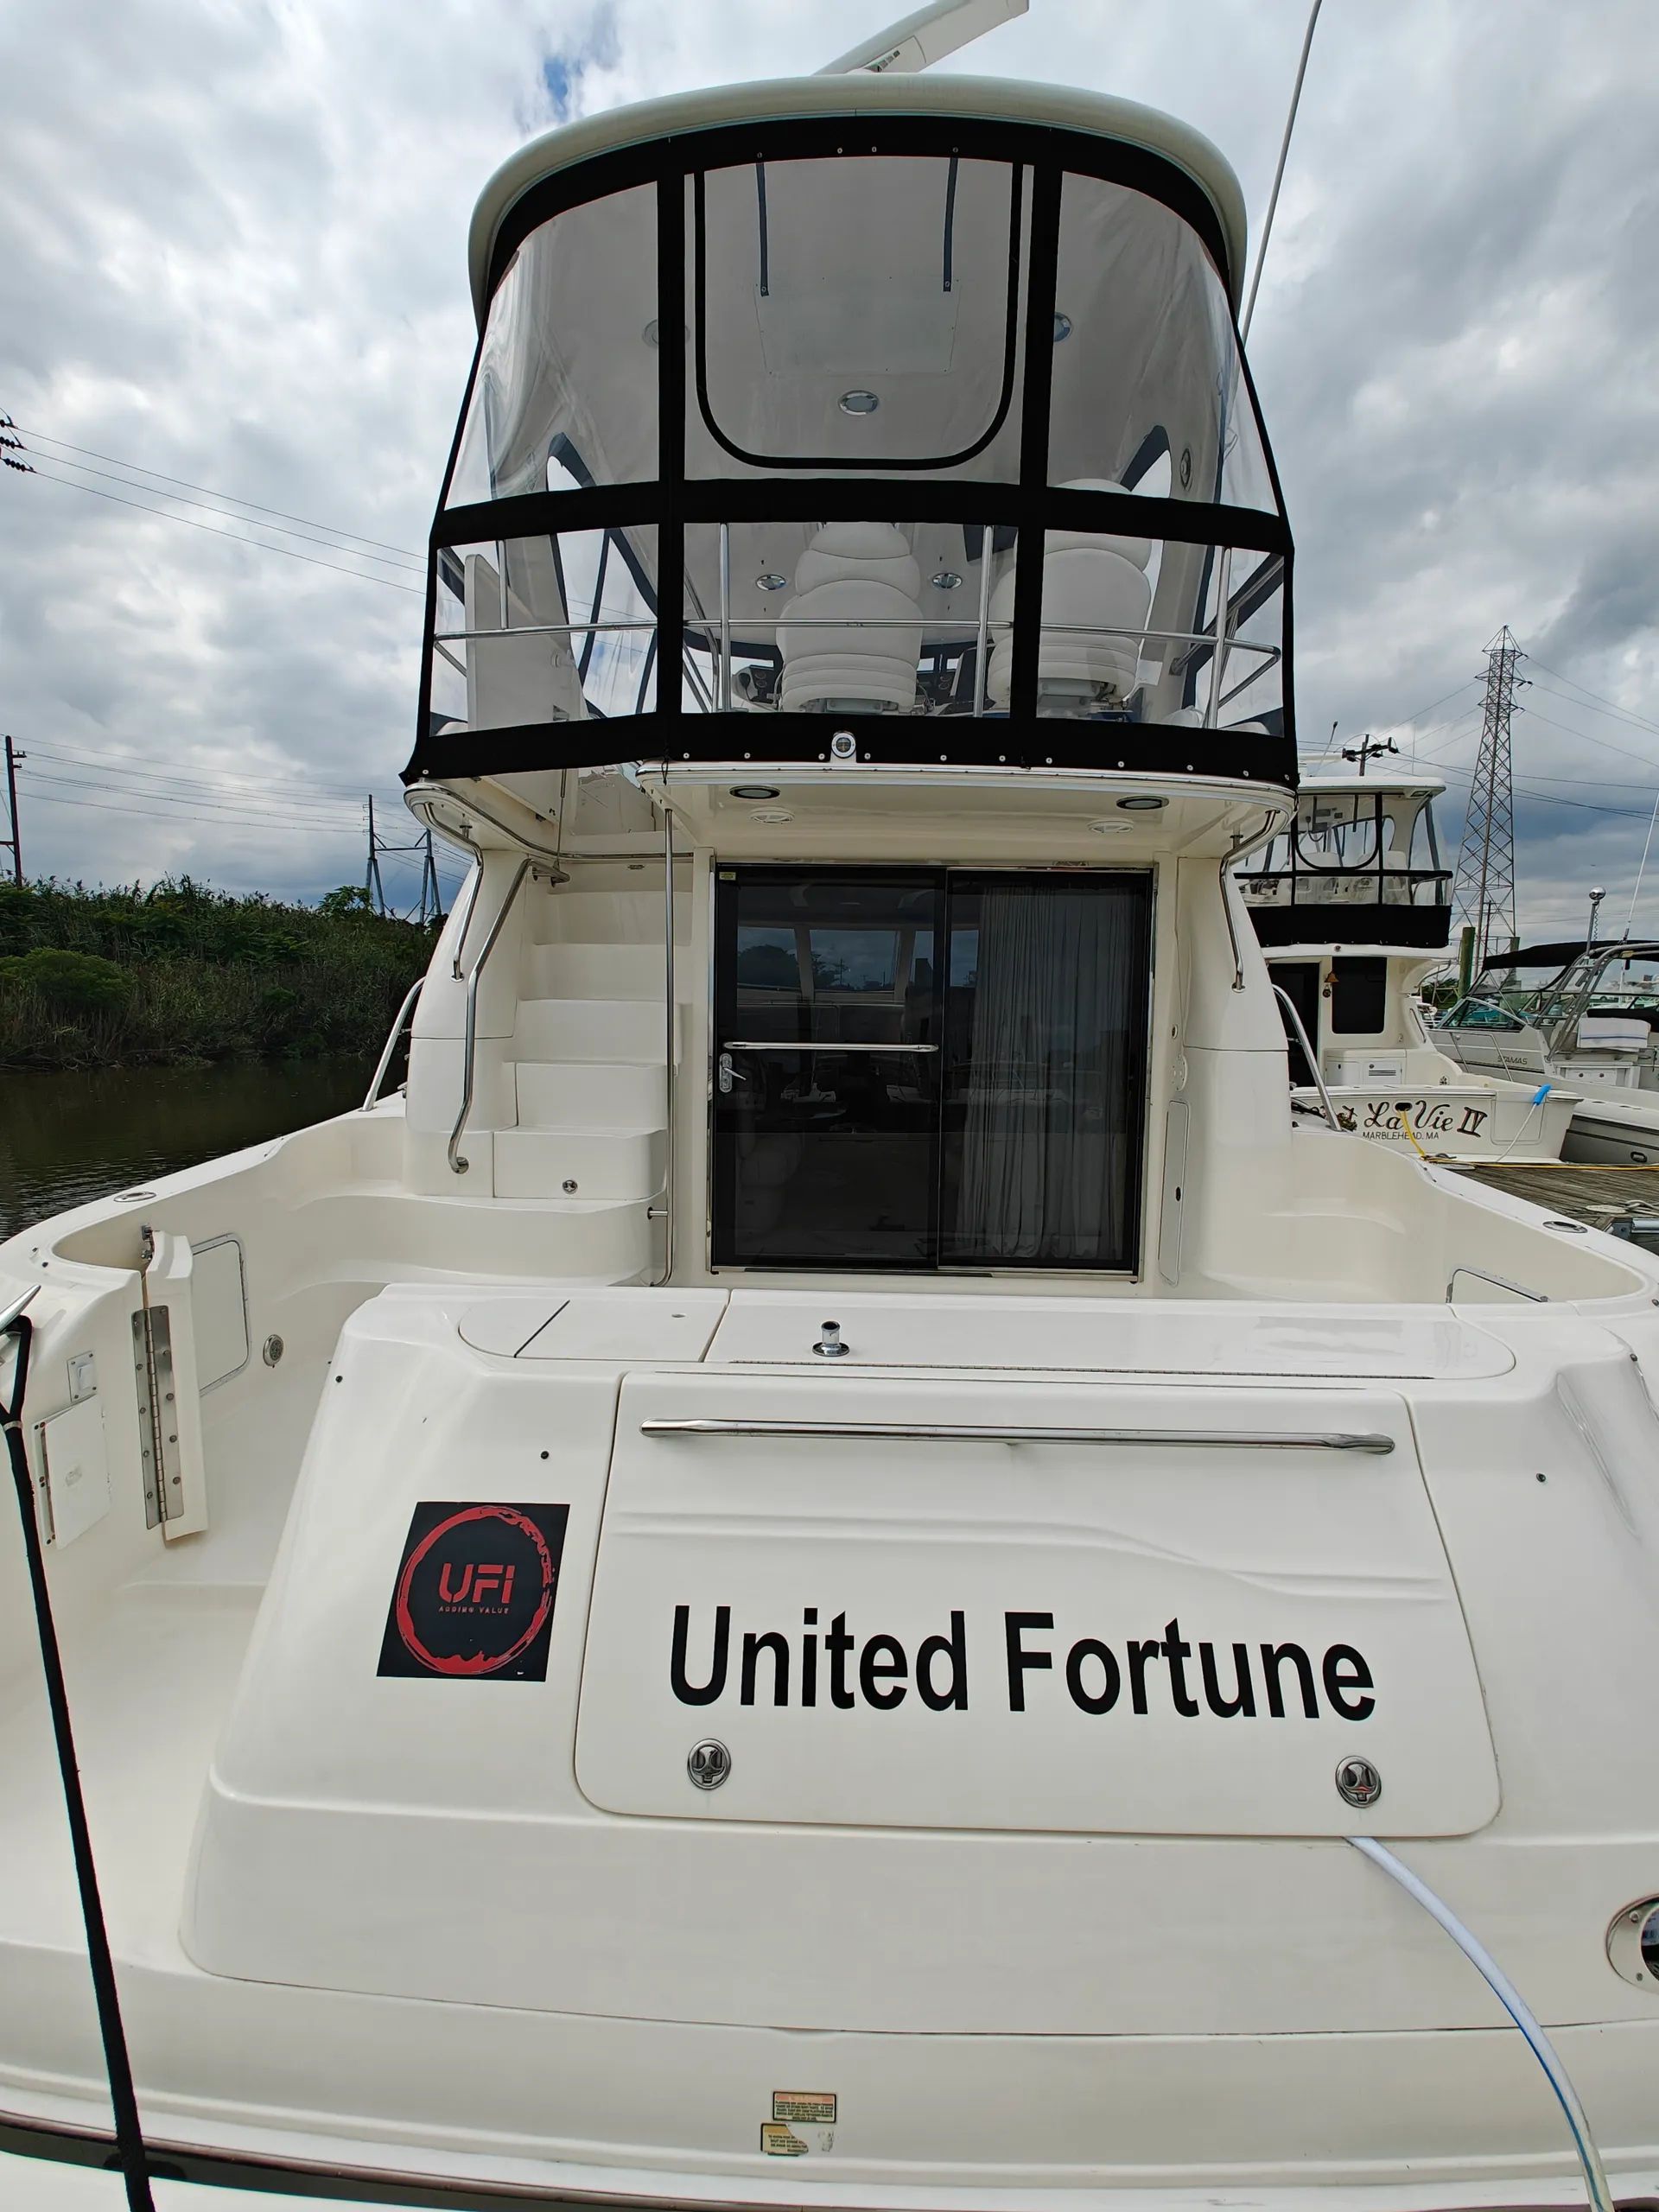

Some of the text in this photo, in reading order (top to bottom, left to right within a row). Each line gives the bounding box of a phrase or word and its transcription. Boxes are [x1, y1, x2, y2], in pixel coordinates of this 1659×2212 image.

[1363, 1101, 1403, 1130] La
[1414, 1100, 1453, 1132] Vie
[1457, 1107, 1488, 1138] IV
[1426, 1131, 1439, 1140] MA
[671, 1605, 1376, 1721] United Fortune
